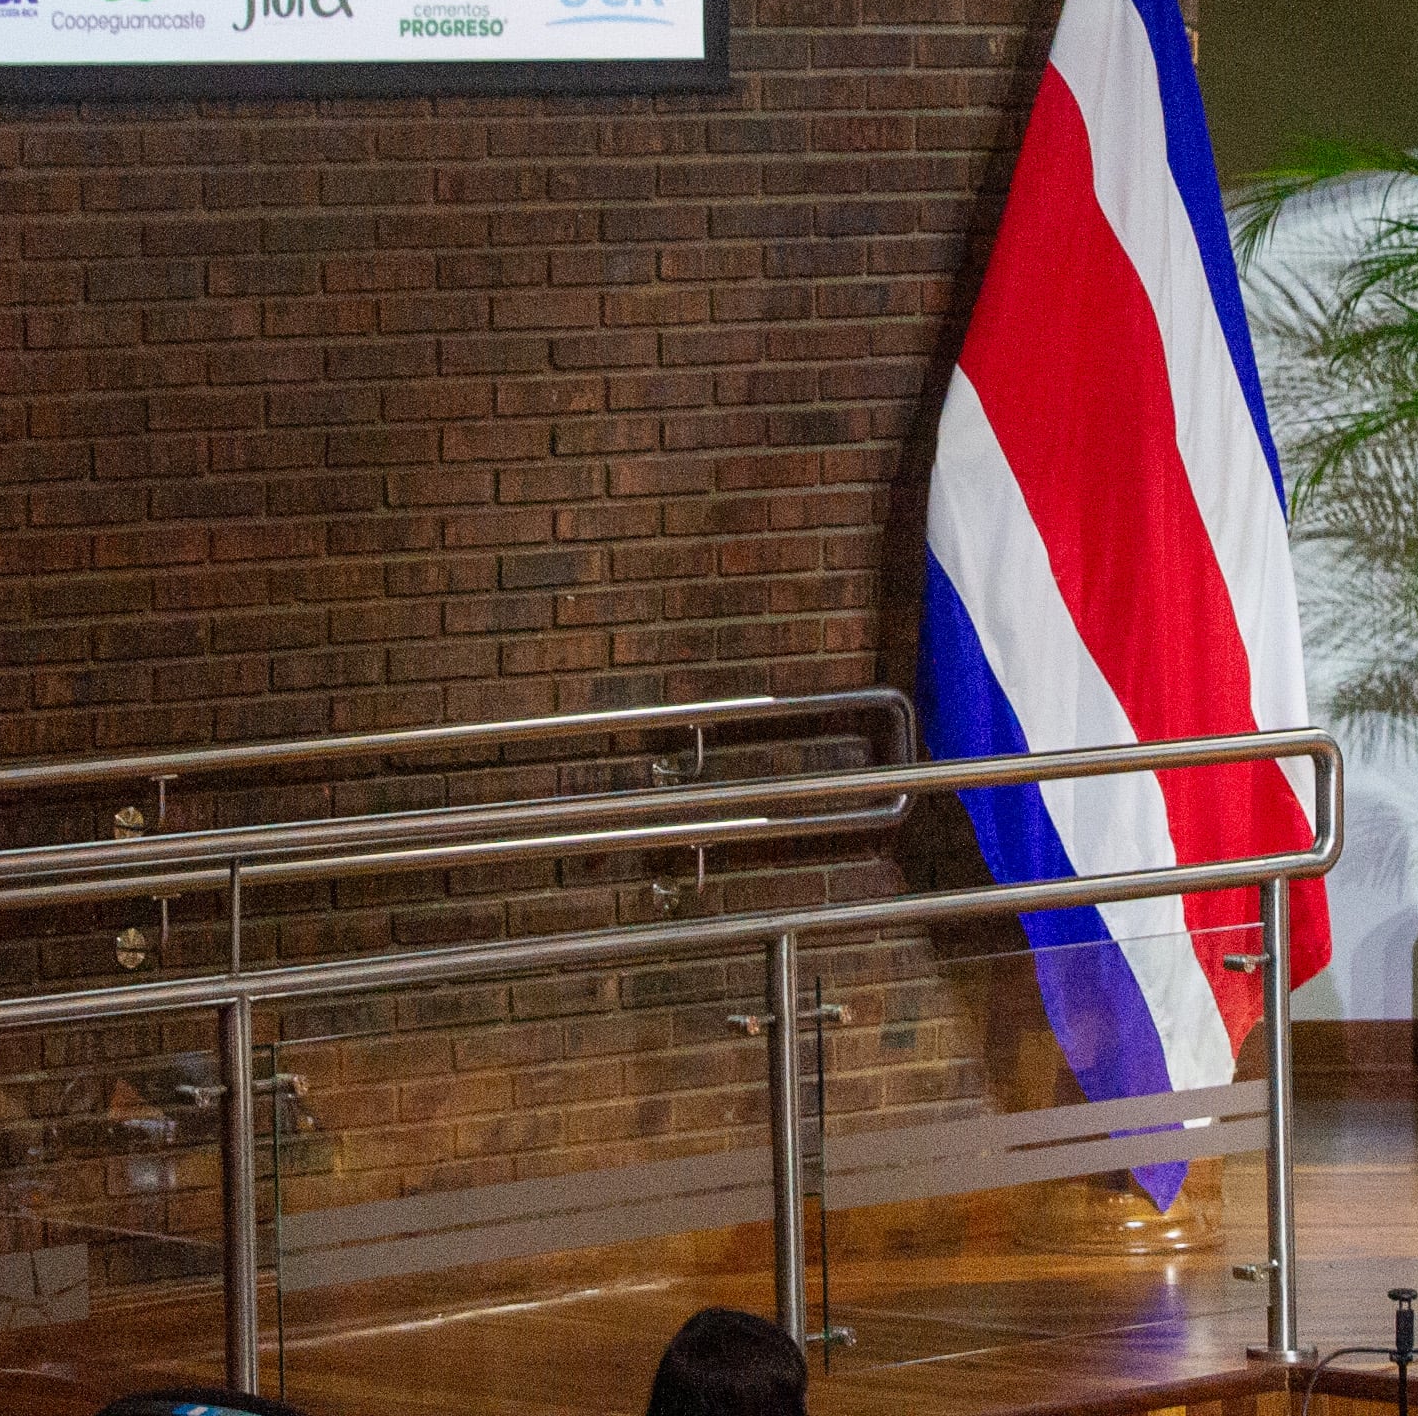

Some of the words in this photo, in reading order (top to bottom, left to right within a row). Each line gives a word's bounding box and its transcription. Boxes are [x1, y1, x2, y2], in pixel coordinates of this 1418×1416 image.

[413, 2, 490, 18] cementos
[51, 10, 206, 35] Coopeguanacaste
[399, 18, 504, 38] PROGRESO
